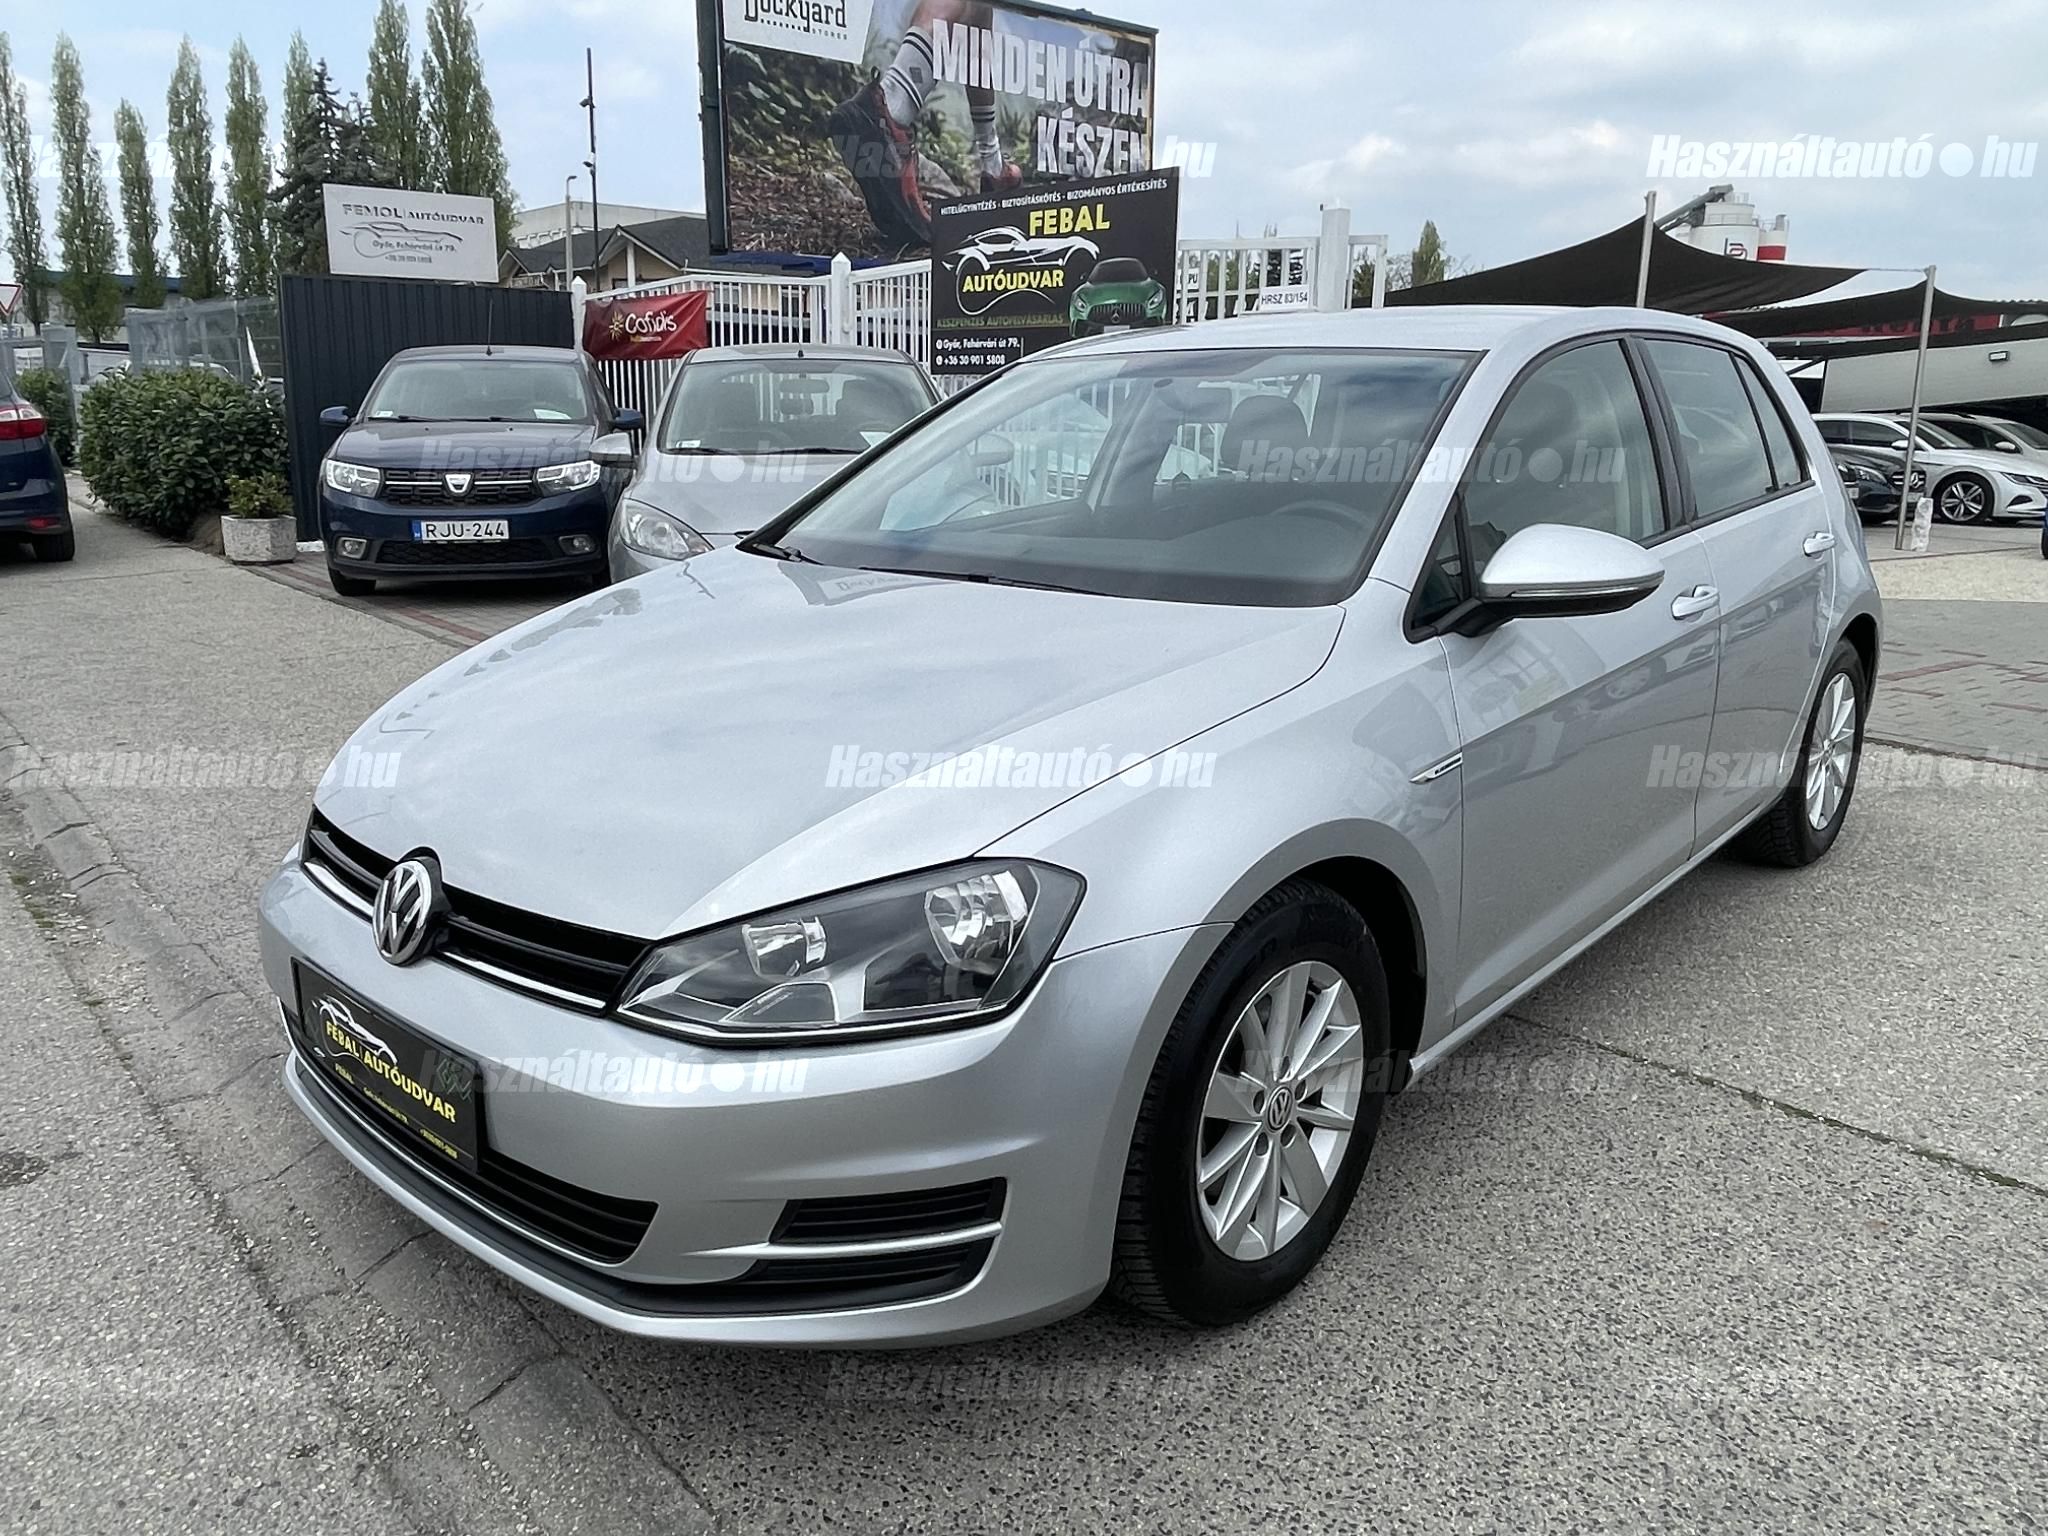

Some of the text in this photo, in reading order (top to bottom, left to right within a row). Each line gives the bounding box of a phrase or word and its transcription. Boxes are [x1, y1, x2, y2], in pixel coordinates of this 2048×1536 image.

[932, 18, 1150, 117] MINDEN ÚTRA
[1037, 107, 1148, 179] KÉSZEN
[1067, 185, 1116, 201] BIZOMÁNYOS
[1117, 178, 1168, 195] ÉRTÉKESÍTÉS
[342, 203, 485, 225] FEMOL AUTÓUDVAR
[1029, 203, 1111, 236] FEBAL
[962, 268, 1065, 293] AUTÓUDVAR
[1261, 291, 1308, 305] HRSZ 83/154
[625, 310, 677, 334] Cofidis
[943, 338, 962, 351] Győr,
[1008, 337, 1020, 348] 79.
[970, 355, 984, 365] 901
[425, 522, 505, 538] RJU-244
[325, 1020, 360, 1057] FEBAL
[364, 1050, 457, 1123] AUTÓUDVAR
